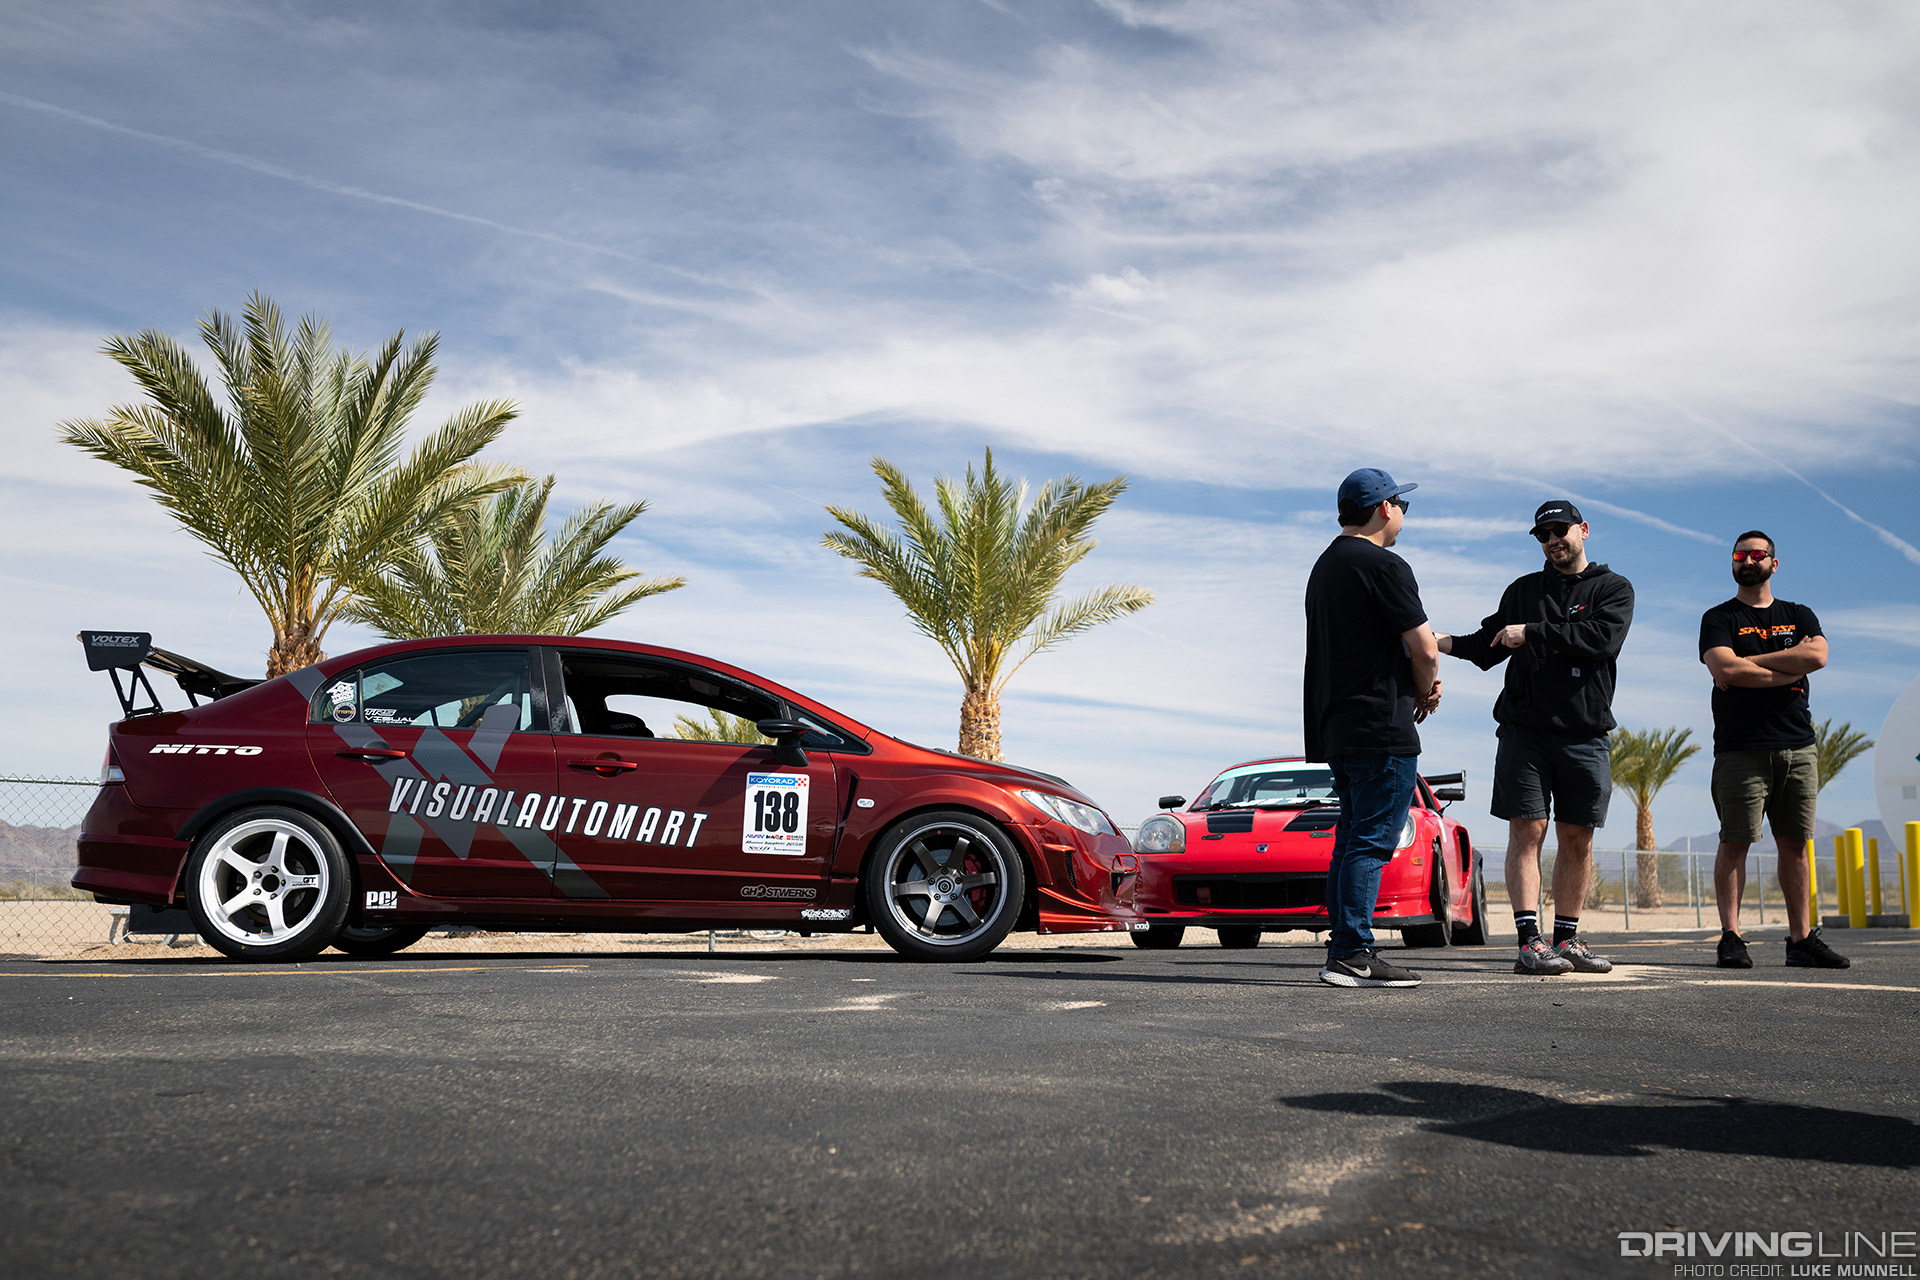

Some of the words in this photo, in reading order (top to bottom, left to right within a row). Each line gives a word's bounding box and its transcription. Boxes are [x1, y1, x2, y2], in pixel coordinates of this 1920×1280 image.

[91, 635, 140, 644] VOLTEX
[149, 744, 263, 756] NITTO
[750, 777, 795, 785] KOYORAD
[387, 776, 709, 848] VISUALAUTOMART
[754, 790, 800, 833] 138
